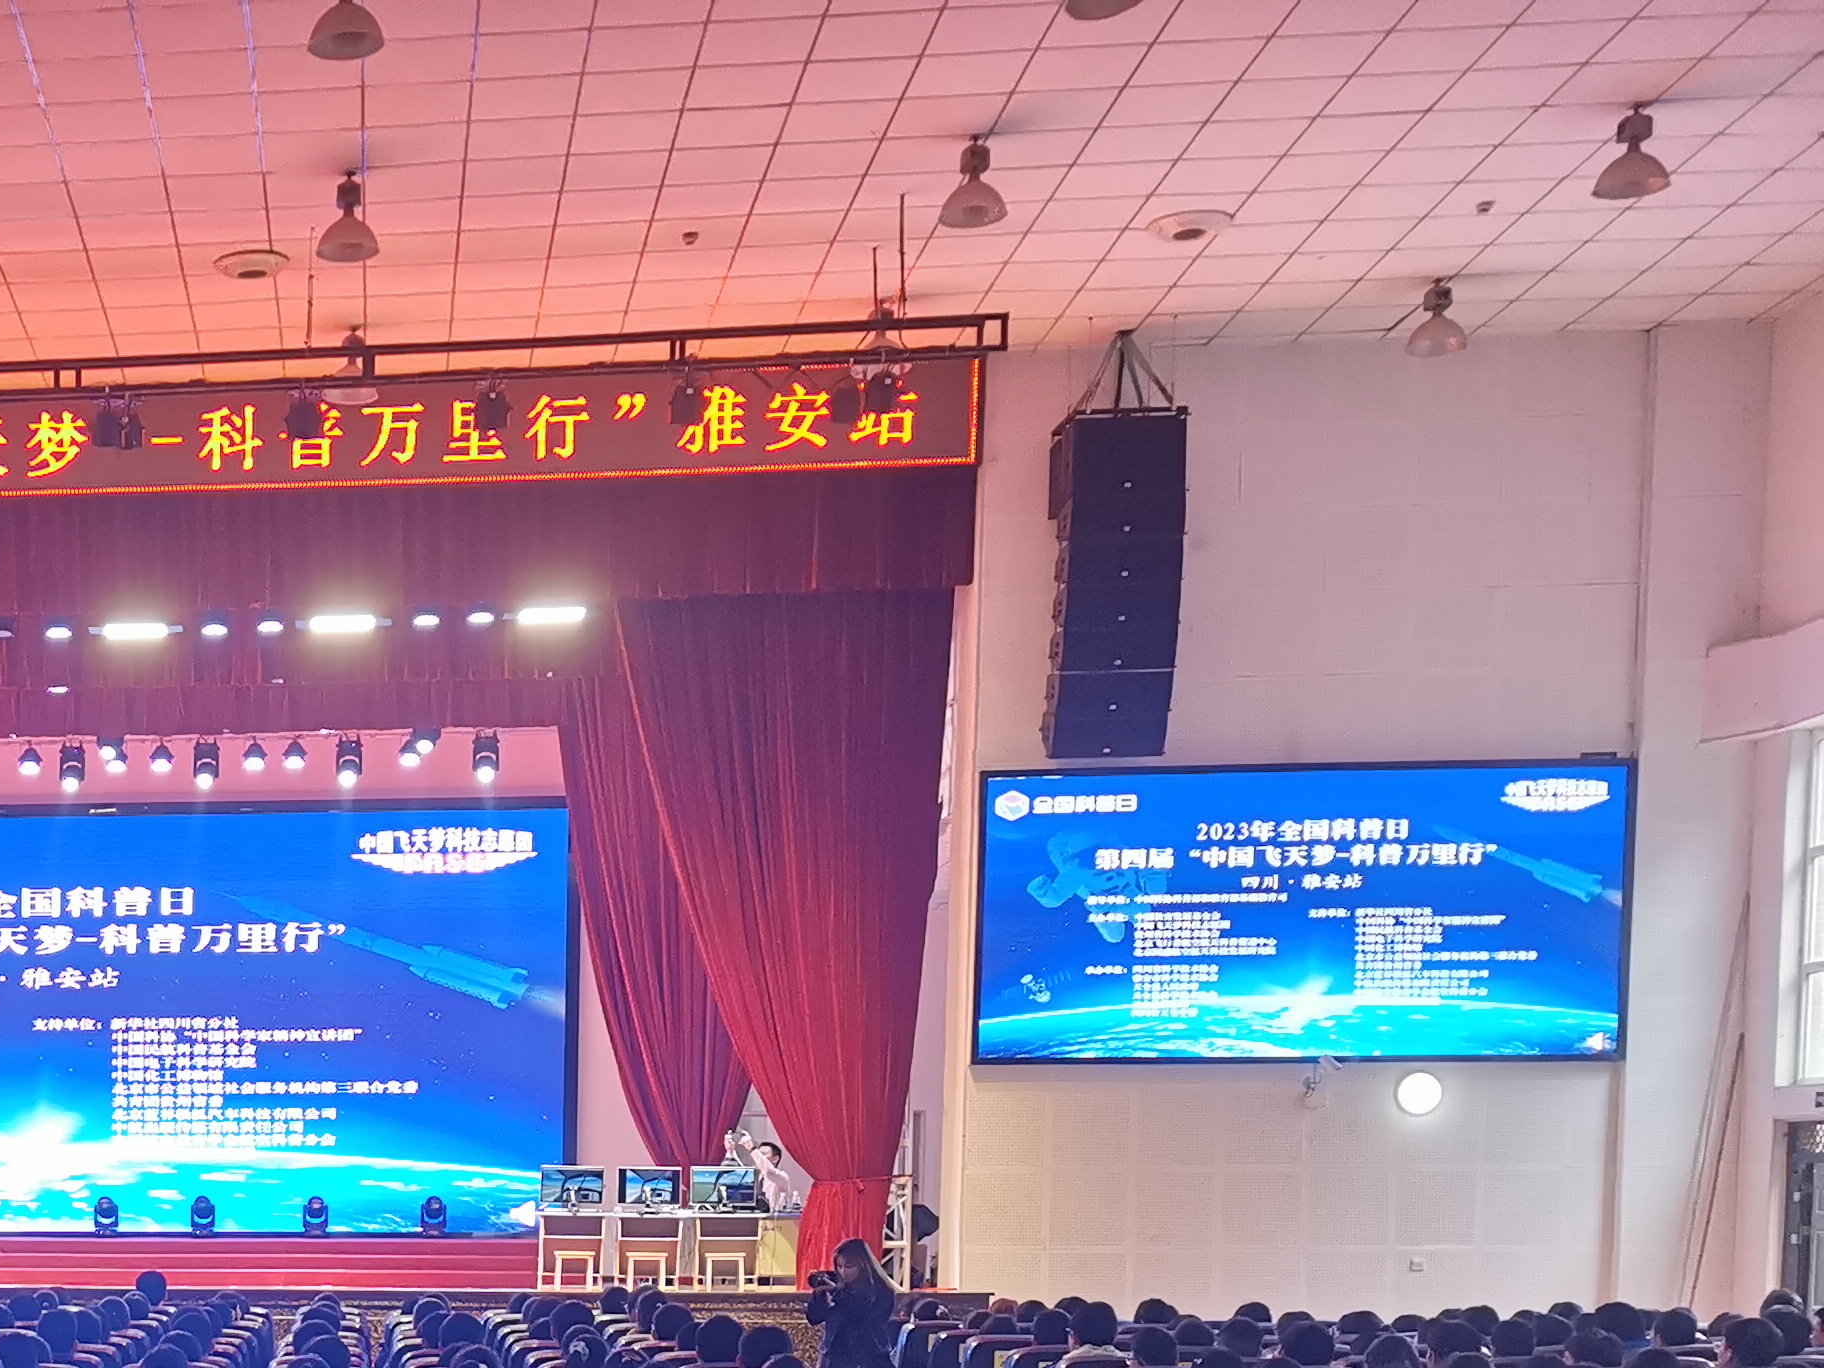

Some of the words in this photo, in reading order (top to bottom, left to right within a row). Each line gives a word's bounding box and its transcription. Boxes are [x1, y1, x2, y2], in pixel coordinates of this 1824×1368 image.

[1032, 794, 1138, 814] 全国科普日
[1196, 819, 1409, 841] 2023年全国科普日
